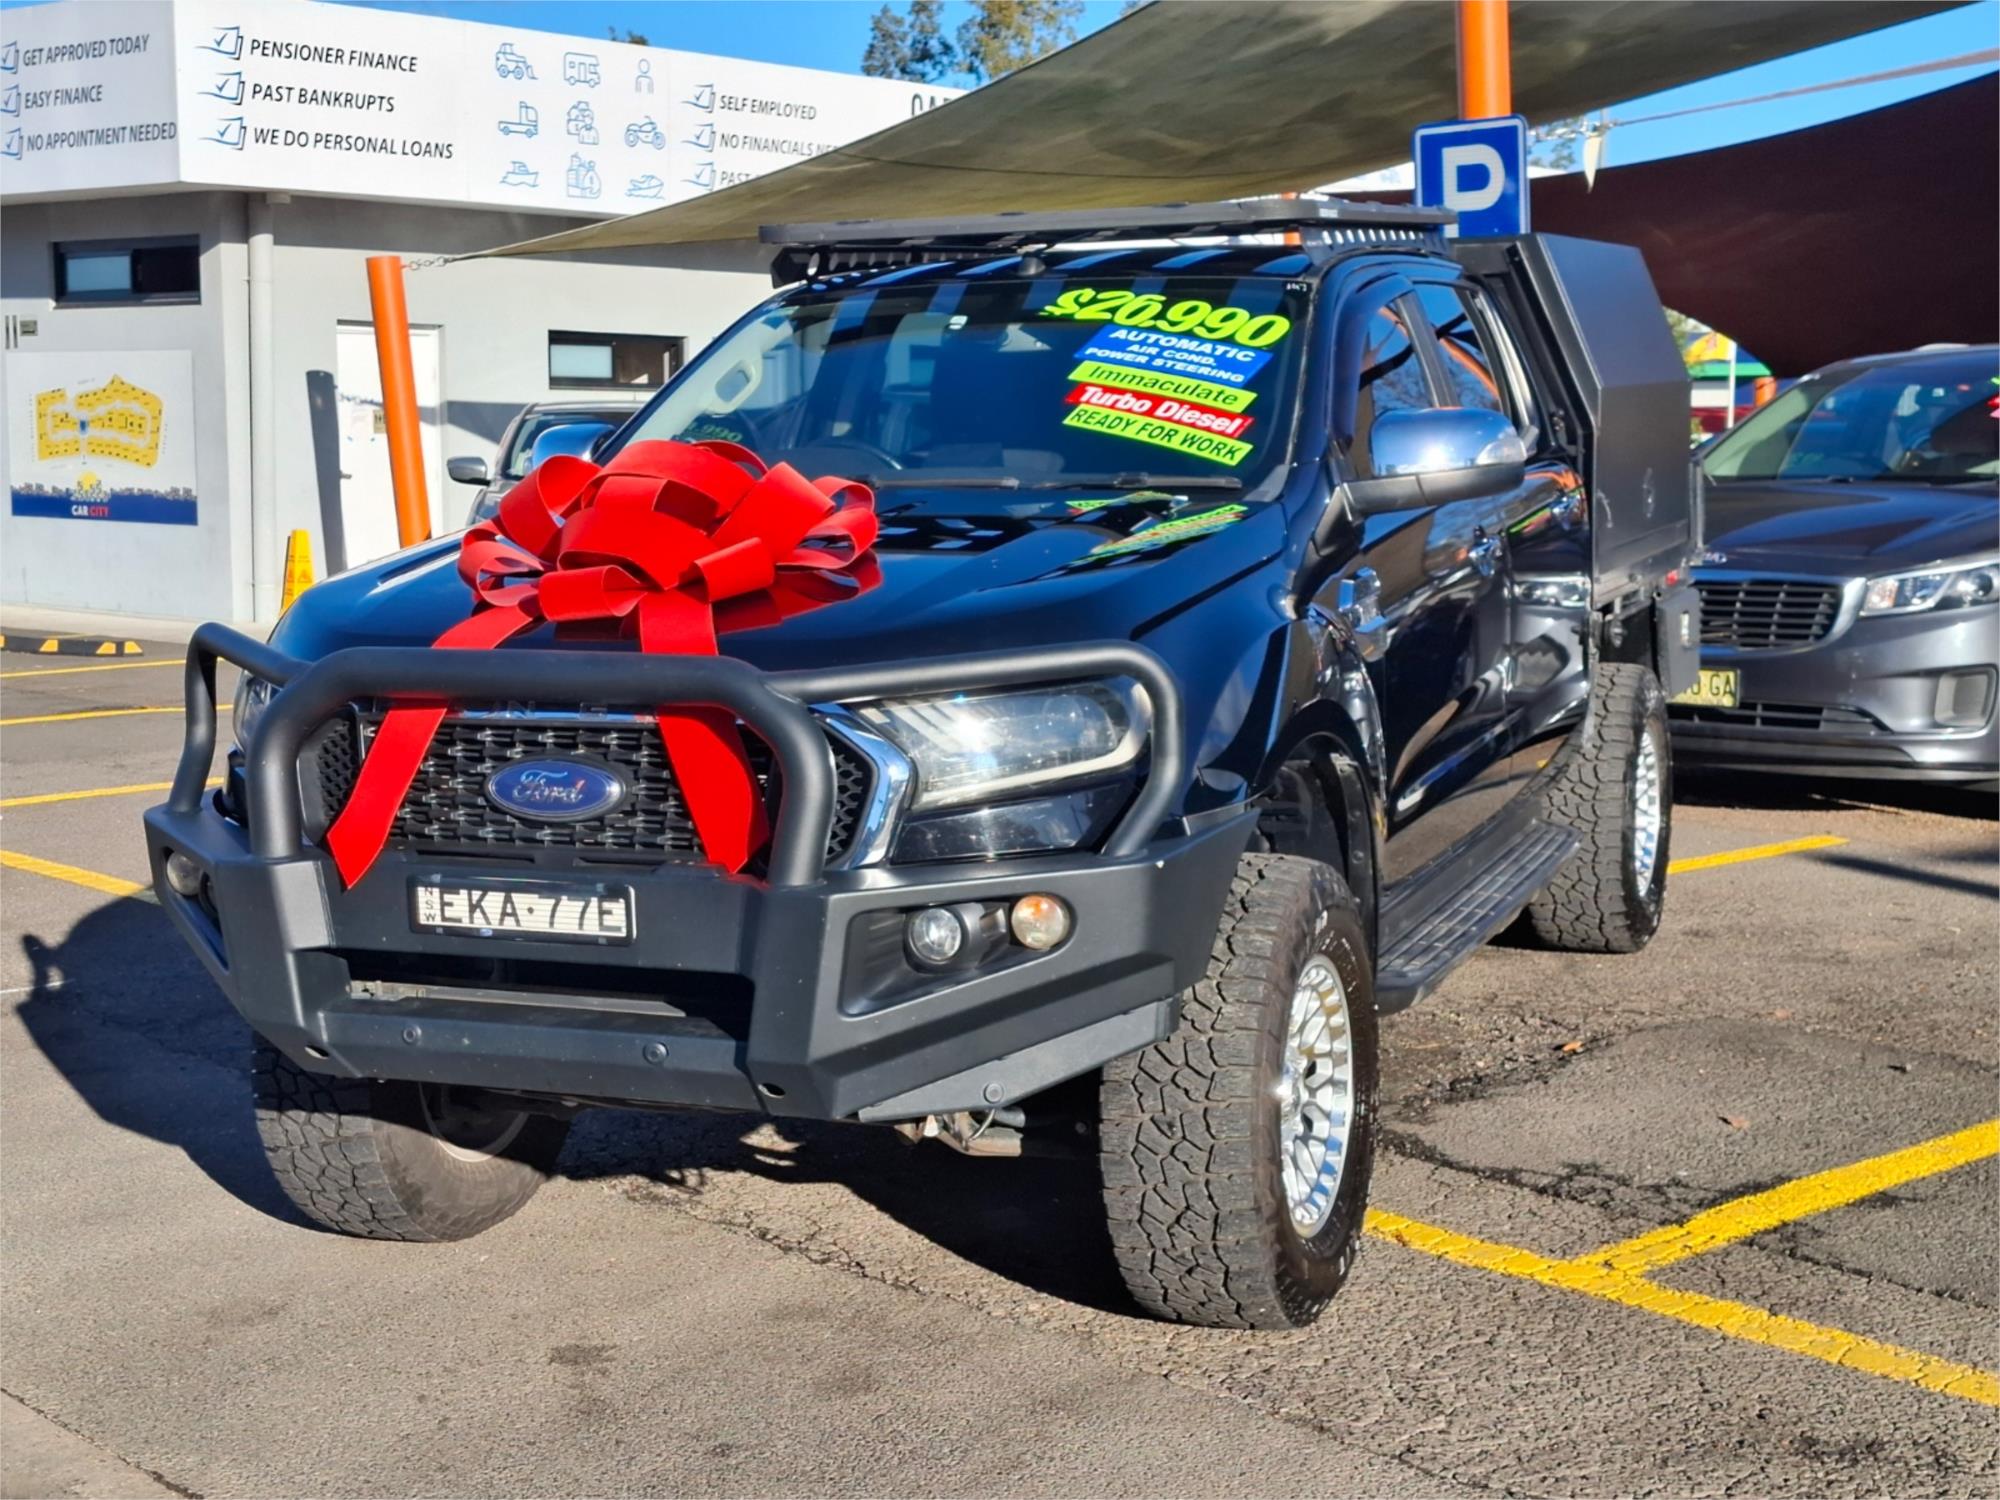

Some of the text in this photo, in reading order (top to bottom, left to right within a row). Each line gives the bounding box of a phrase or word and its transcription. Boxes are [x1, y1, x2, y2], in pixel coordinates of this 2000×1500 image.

[23, 34, 149, 66] GET APPROVED TODAY
[250, 39, 418, 72] PENSIONER FINANCE
[25, 84, 103, 109] EASY FINANCE
[251, 83, 395, 113] PAST BANKRUPTS
[720, 95, 817, 120] SELF EMPLOYED
[27, 122, 177, 151] NO APPOINTMENT NEEDED
[254, 127, 454, 159] WE DO PERSONAL LOANS
[720, 133, 739, 149] NO
[742, 135, 814, 156] FINANCIALS
[1441, 143, 1505, 238] P
[1109, 329, 1256, 362] AUTOMATIC
[1126, 343, 1217, 366] AIR COND.
[1084, 348, 1245, 383] POWER STEERING
[1088, 366, 1239, 406] Immaculate
[1079, 386, 1243, 435] Turbo Diesel
[1070, 409, 1243, 461] READY FOR WORK
[71, 505, 109, 517] CAR CITY
[512, 769, 586, 803] Ford
